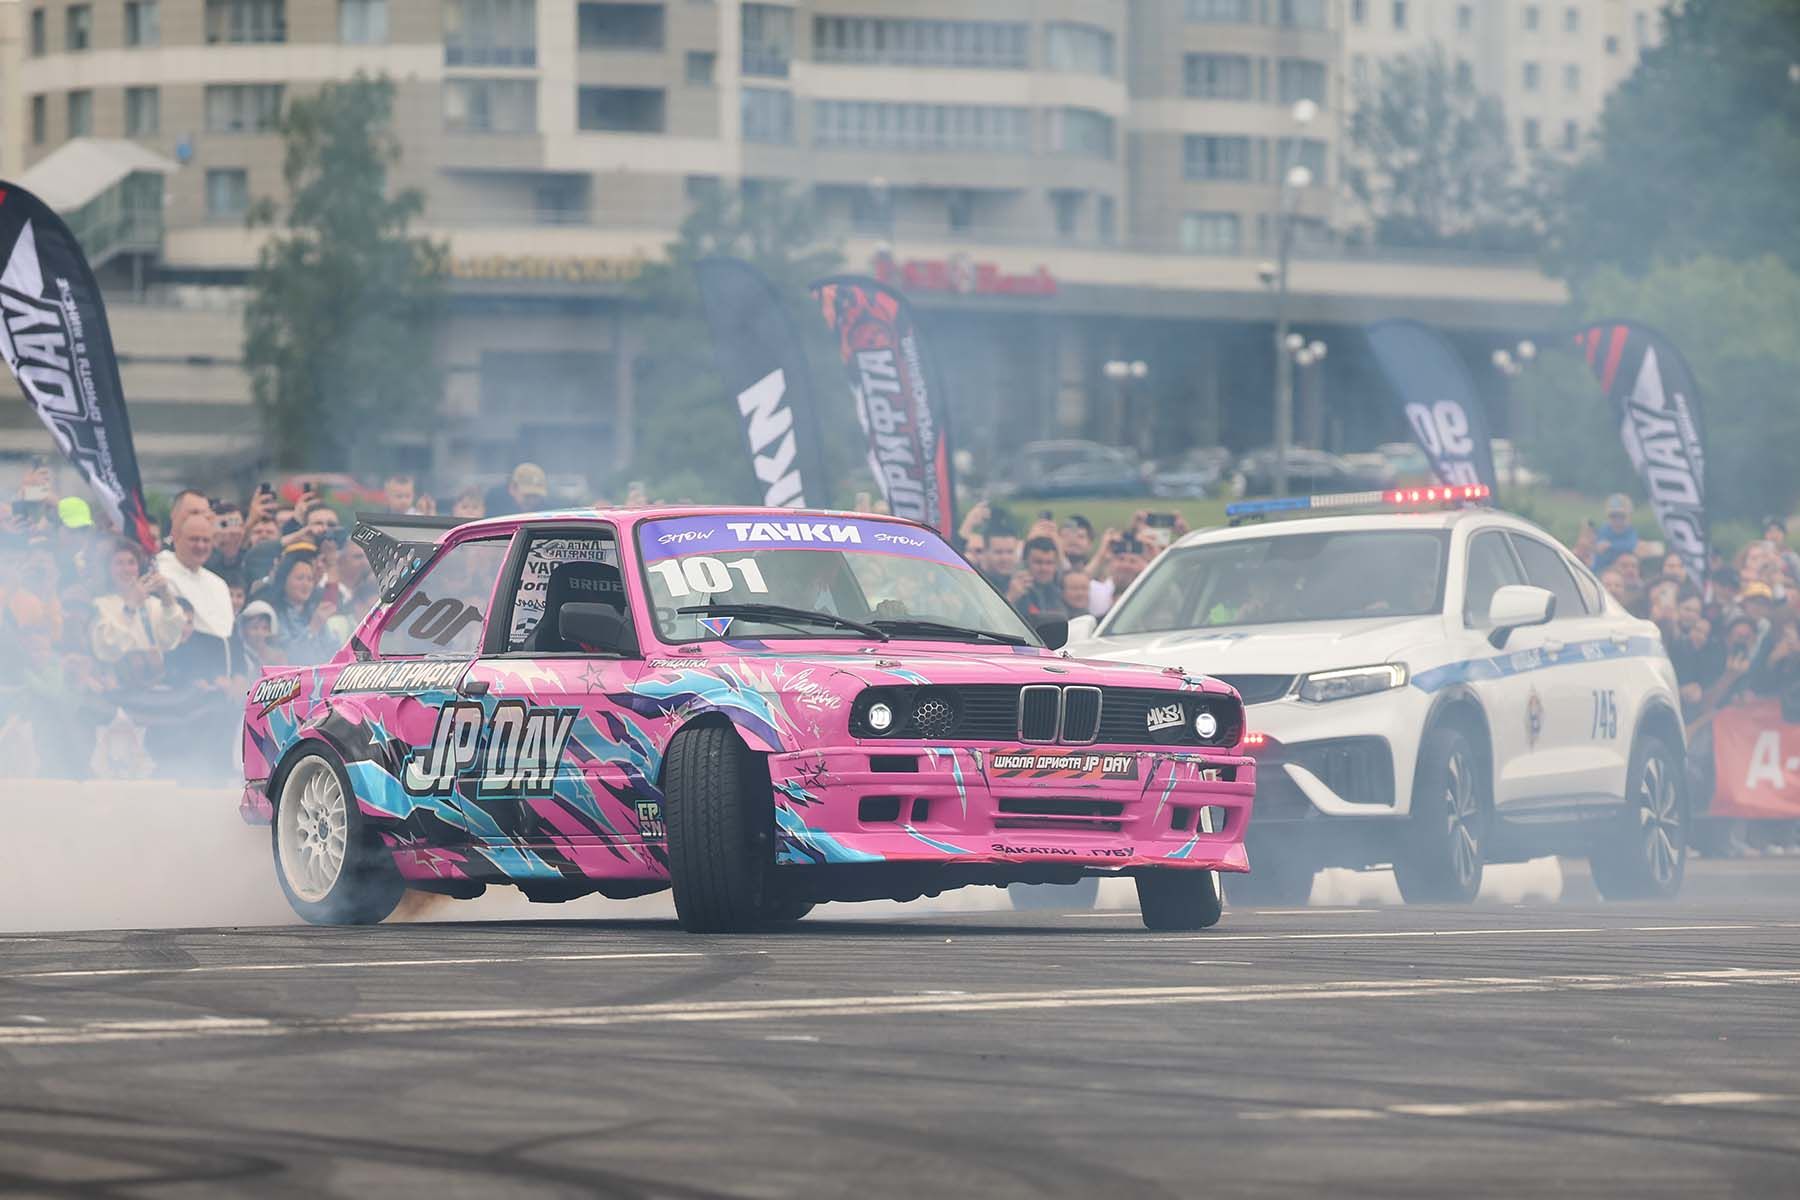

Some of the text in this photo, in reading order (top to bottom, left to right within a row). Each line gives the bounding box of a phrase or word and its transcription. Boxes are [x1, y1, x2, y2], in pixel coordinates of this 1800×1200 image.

[0, 293, 80, 414] DAY
[1630, 403, 1702, 506] DAY
[727, 522, 863, 545] ТАЧКИ
[647, 556, 769, 598] 101
[252, 675, 301, 703] Divinol
[333, 661, 467, 690] ШКОЛА ДРИФТА
[1591, 689, 1617, 740] 745
[405, 706, 574, 790] JP DAY
[994, 755, 1132, 773] ШКОЛА ДРИФТА JP DAY
